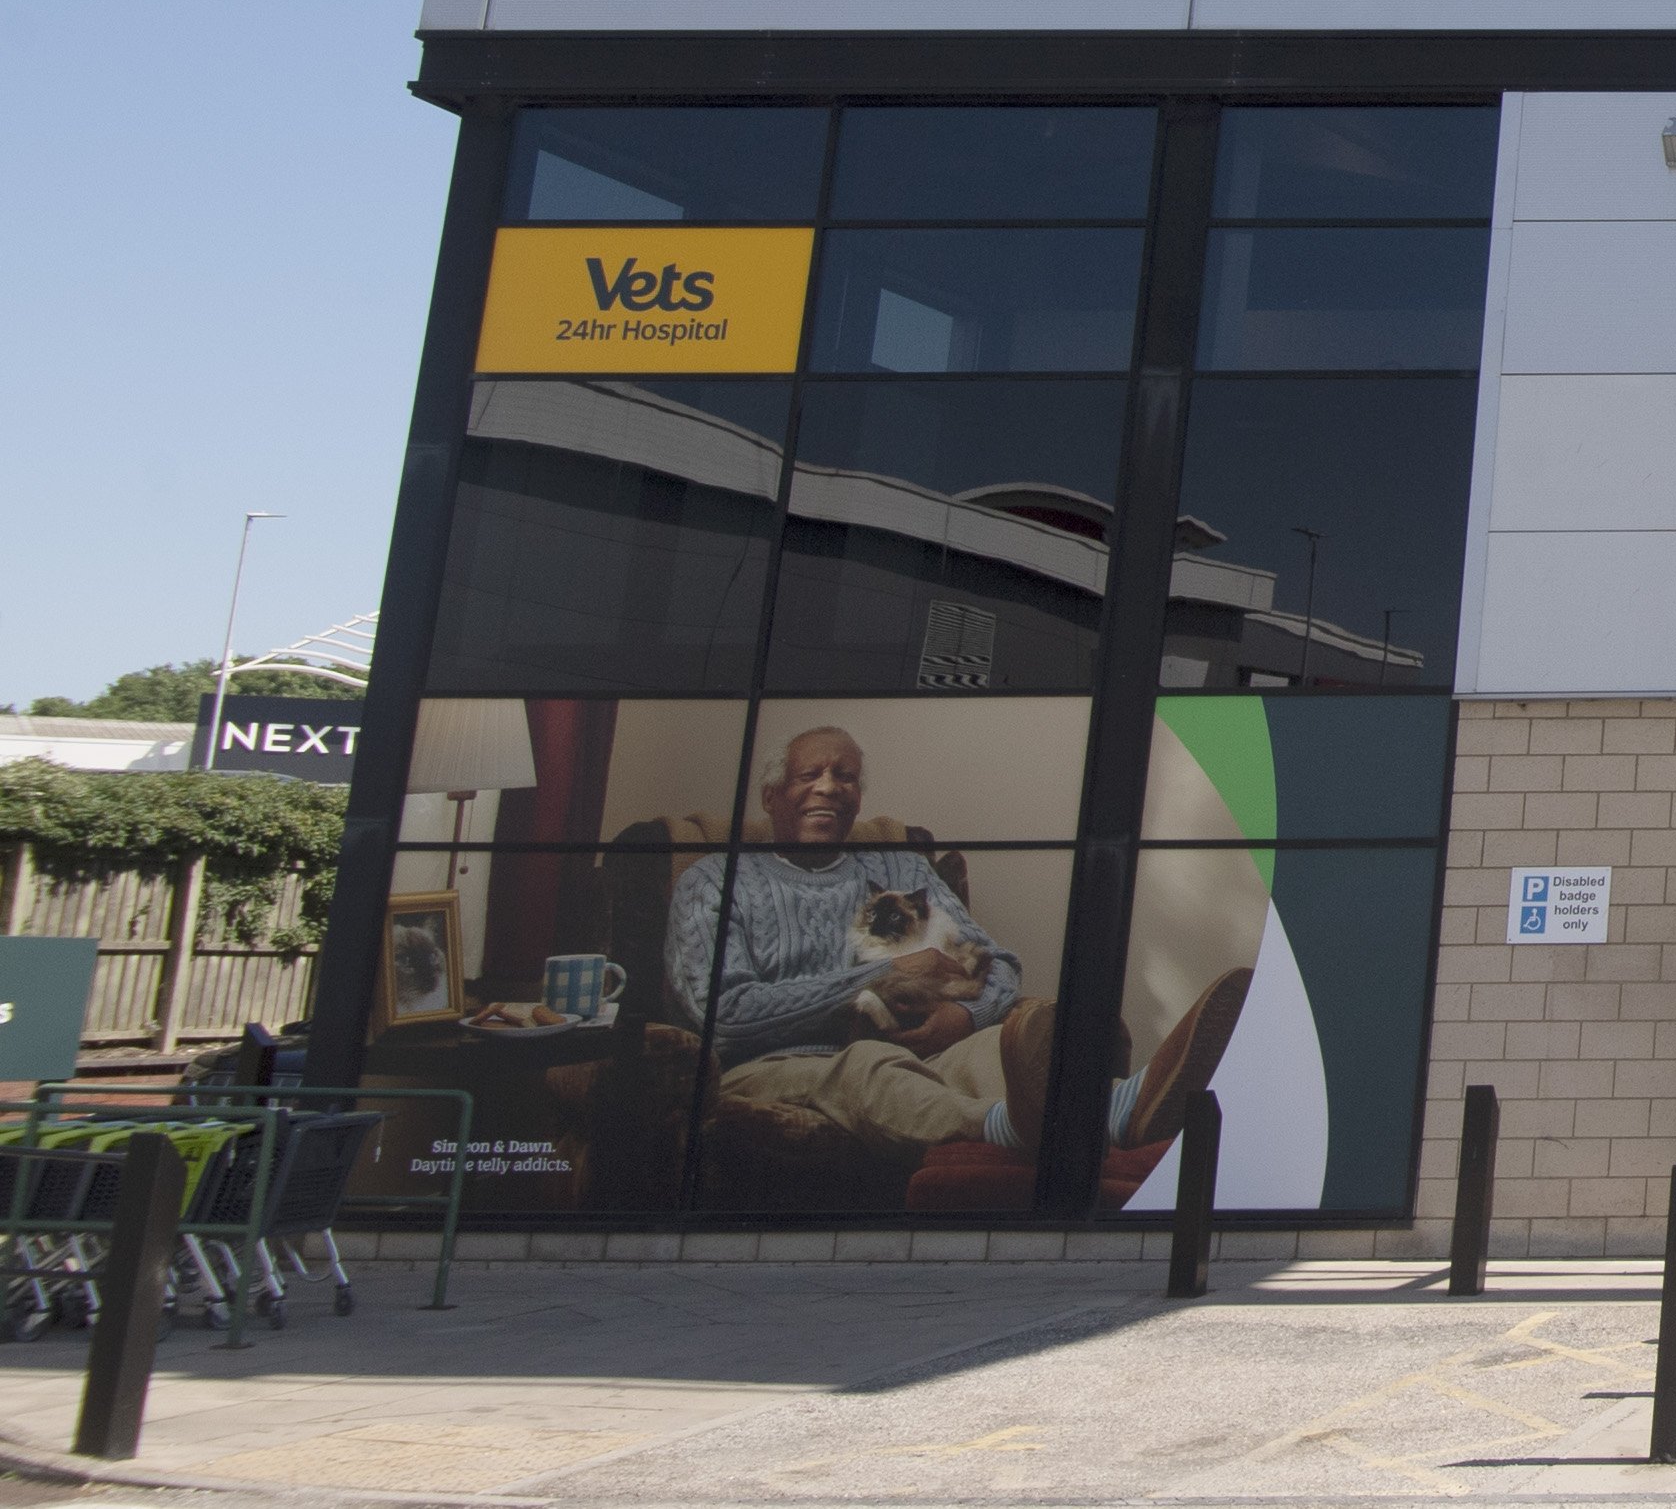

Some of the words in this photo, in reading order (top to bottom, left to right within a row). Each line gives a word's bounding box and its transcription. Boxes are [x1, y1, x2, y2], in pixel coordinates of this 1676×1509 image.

[586, 258, 714, 311] Vets
[556, 319, 616, 340] 24hr
[622, 318, 728, 346] Hospital
[221, 721, 361, 755] NEXT
[1527, 878, 1544, 900] P
[1553, 876, 1605, 887] Disabled
[1560, 891, 1596, 903] badge
[1554, 905, 1599, 915] holders
[1563, 919, 1588, 931] only
[493, 1140, 505, 1153] &
[509, 1140, 556, 1153] Dawn.
[478, 1157, 511, 1174] telly
[514, 1157, 572, 1172] addicts.
